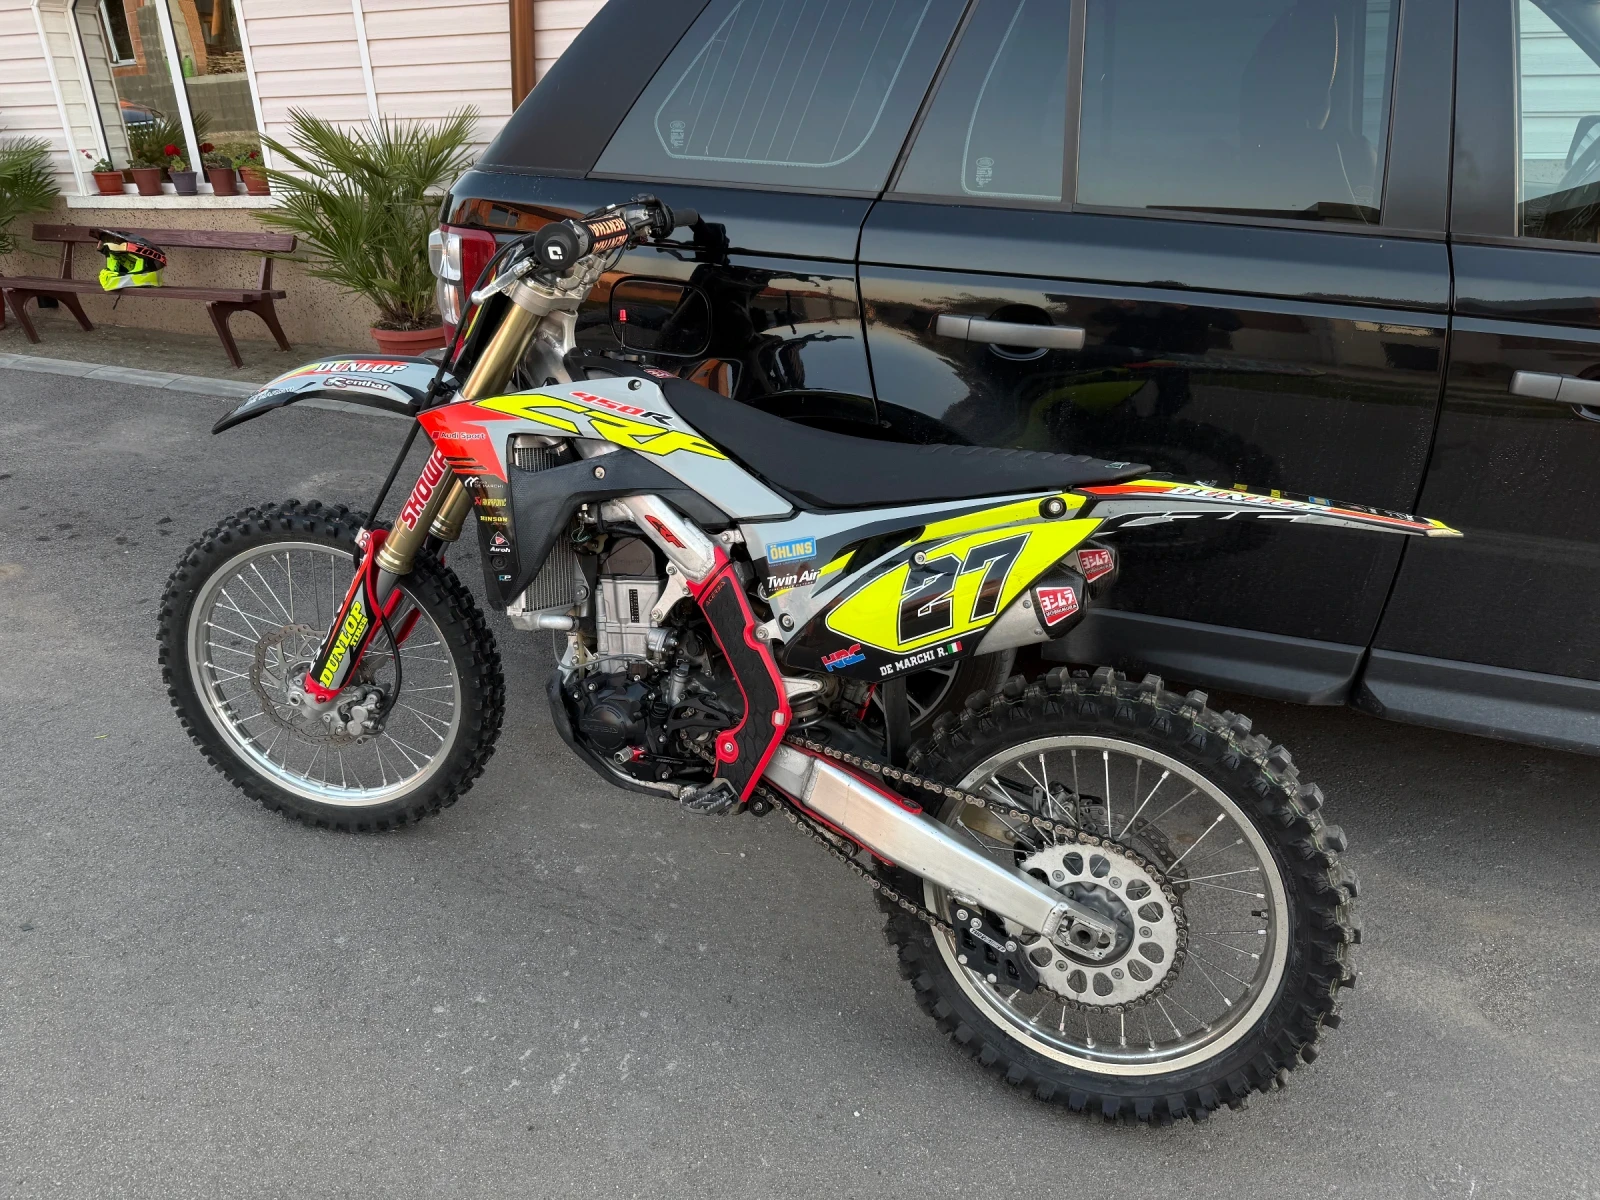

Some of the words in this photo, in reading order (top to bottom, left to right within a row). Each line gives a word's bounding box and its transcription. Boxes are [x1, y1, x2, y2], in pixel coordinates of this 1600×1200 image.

[314, 362, 409, 374] DUNLOP
[323, 377, 391, 391] Renthal
[570, 391, 677, 429] 450R
[440, 431, 459, 440] Audi
[460, 432, 486, 441] Sport
[770, 541, 813, 560] ÖHLINS
[767, 573, 798, 589] Twin
[798, 569, 820, 583] Air
[898, 531, 1033, 645] 27
[1041, 589, 1075, 611] ヨシムラ
[319, 600, 364, 688] DUNLOP
[350, 615, 369, 648] TIRES
[821, 642, 866, 673] HRC
[879, 664, 894, 677] DE
[895, 652, 936, 672] MARCHI
[936, 646, 949, 657] R.
